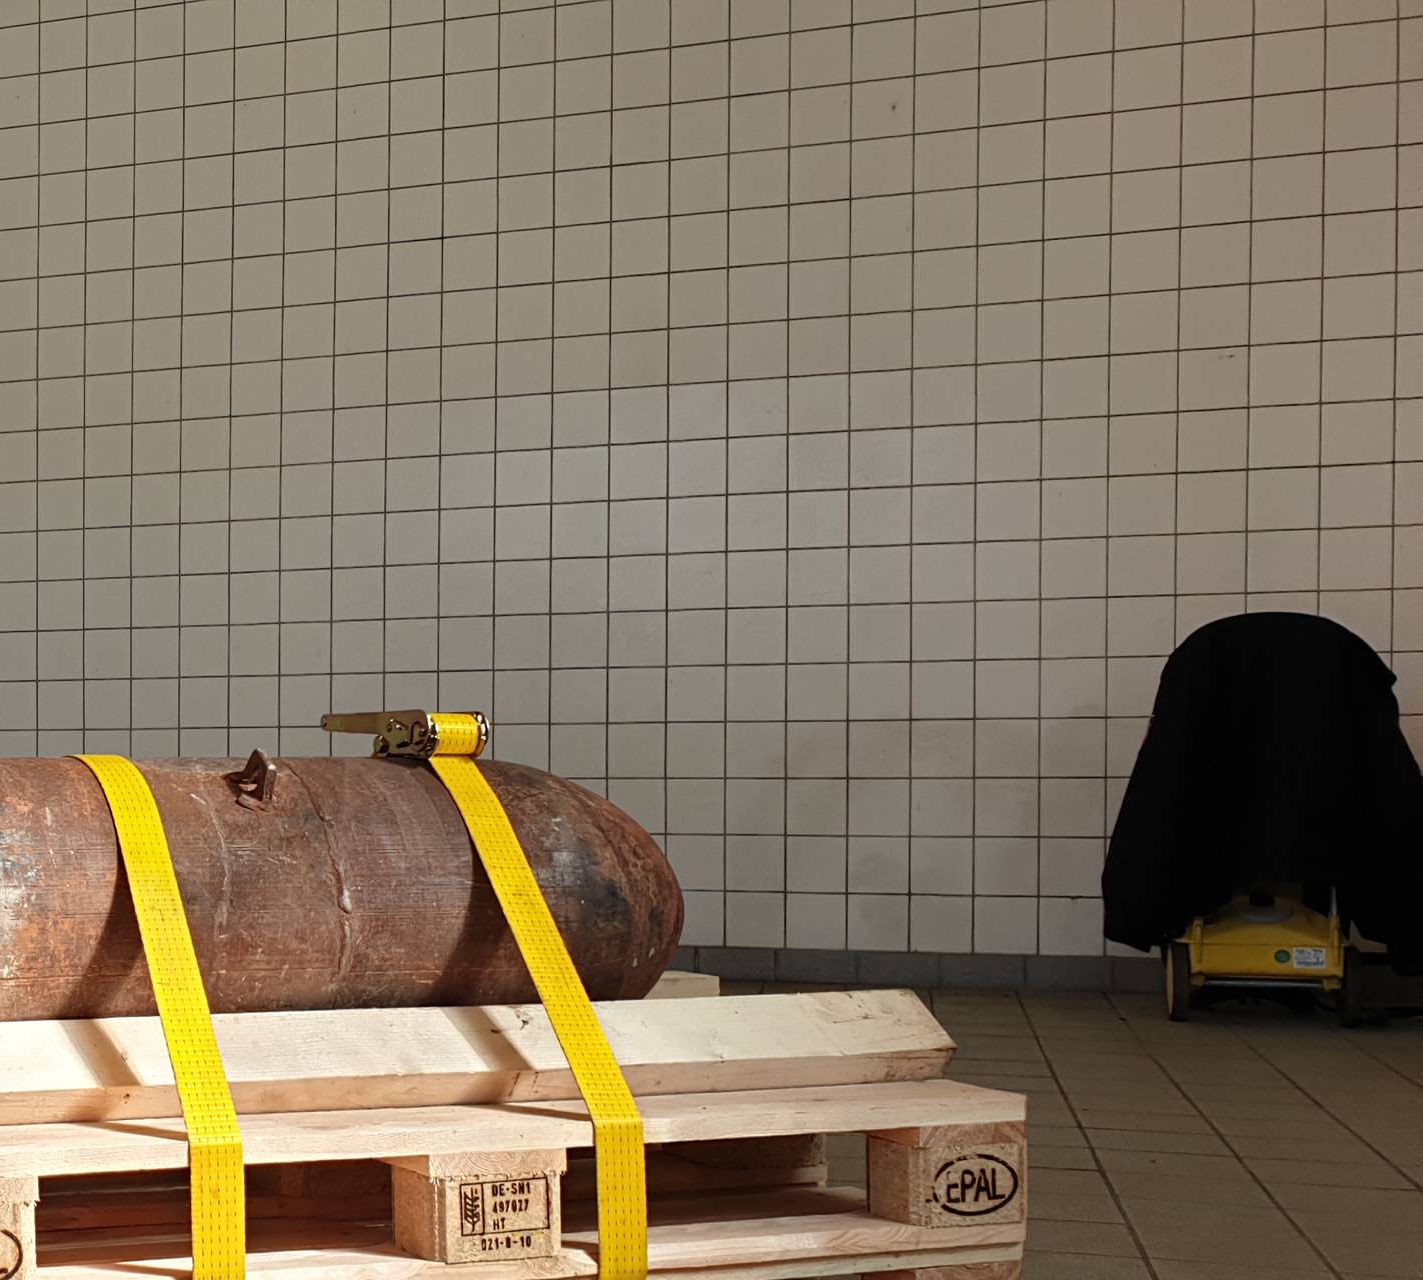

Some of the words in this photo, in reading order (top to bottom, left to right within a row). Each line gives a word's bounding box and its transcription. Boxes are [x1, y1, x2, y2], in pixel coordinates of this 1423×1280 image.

[946, 1167, 1006, 1204] EPAL
[492, 1198, 530, 1214] 497027
[493, 1217, 506, 1231] HT
